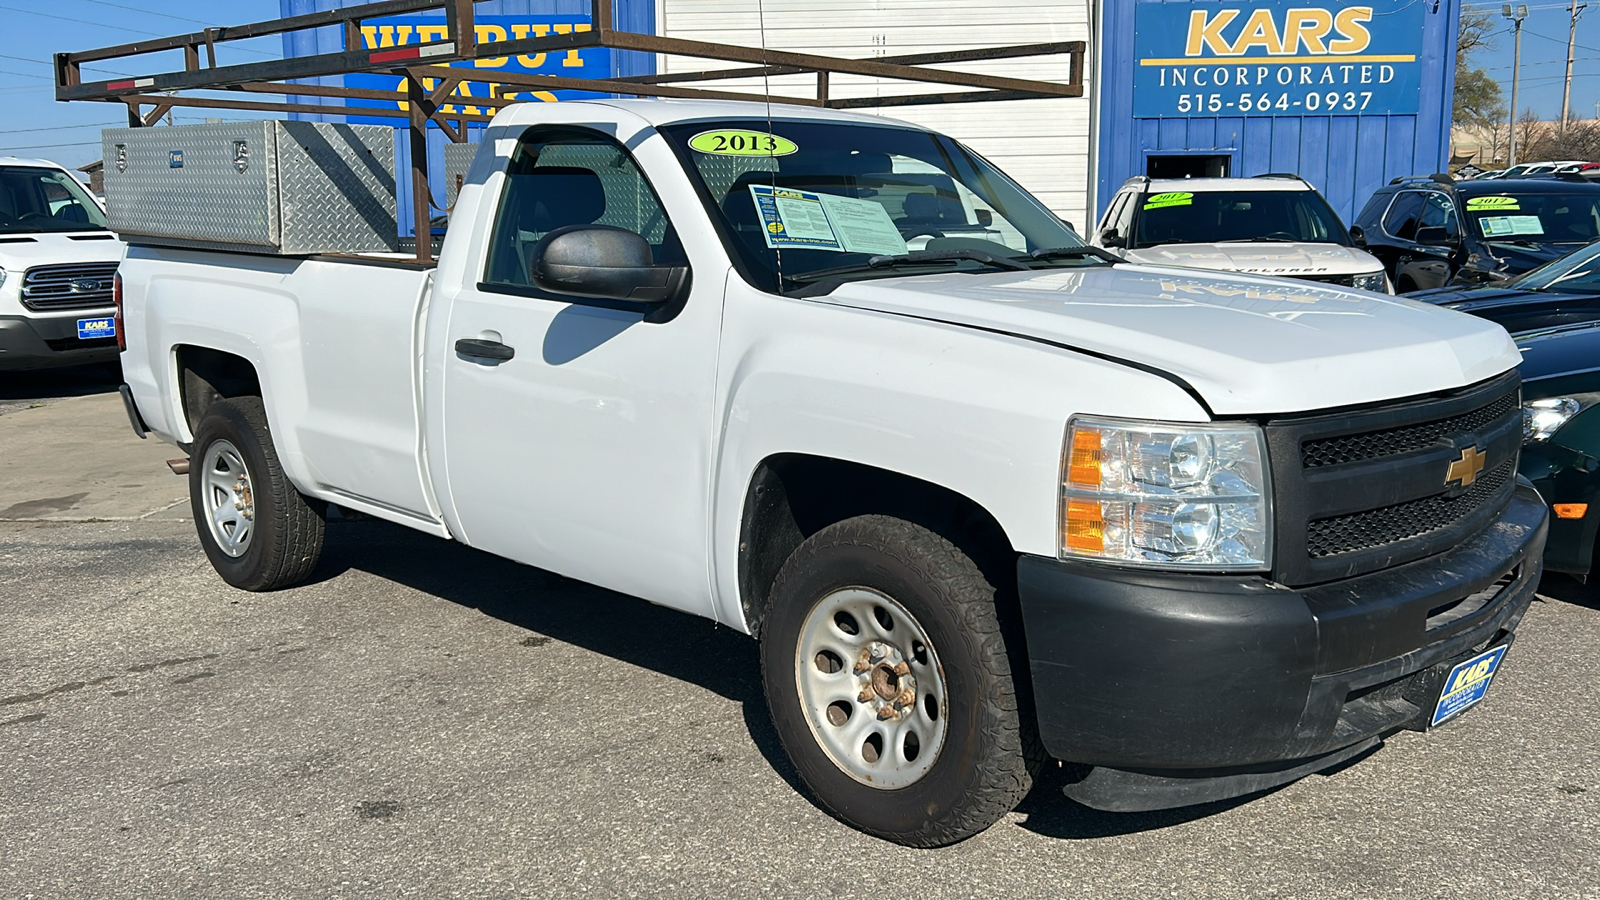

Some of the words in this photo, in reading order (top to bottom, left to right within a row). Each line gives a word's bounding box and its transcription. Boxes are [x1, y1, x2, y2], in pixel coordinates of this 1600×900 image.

[1185, 7, 1373, 56] KARS
[1159, 65, 1395, 87] INCORPORATED
[1177, 91, 1373, 112] 515-564-0937
[712, 135, 777, 151] 2013
[85, 321, 109, 330] KARS
[1450, 655, 1496, 692] KARS
